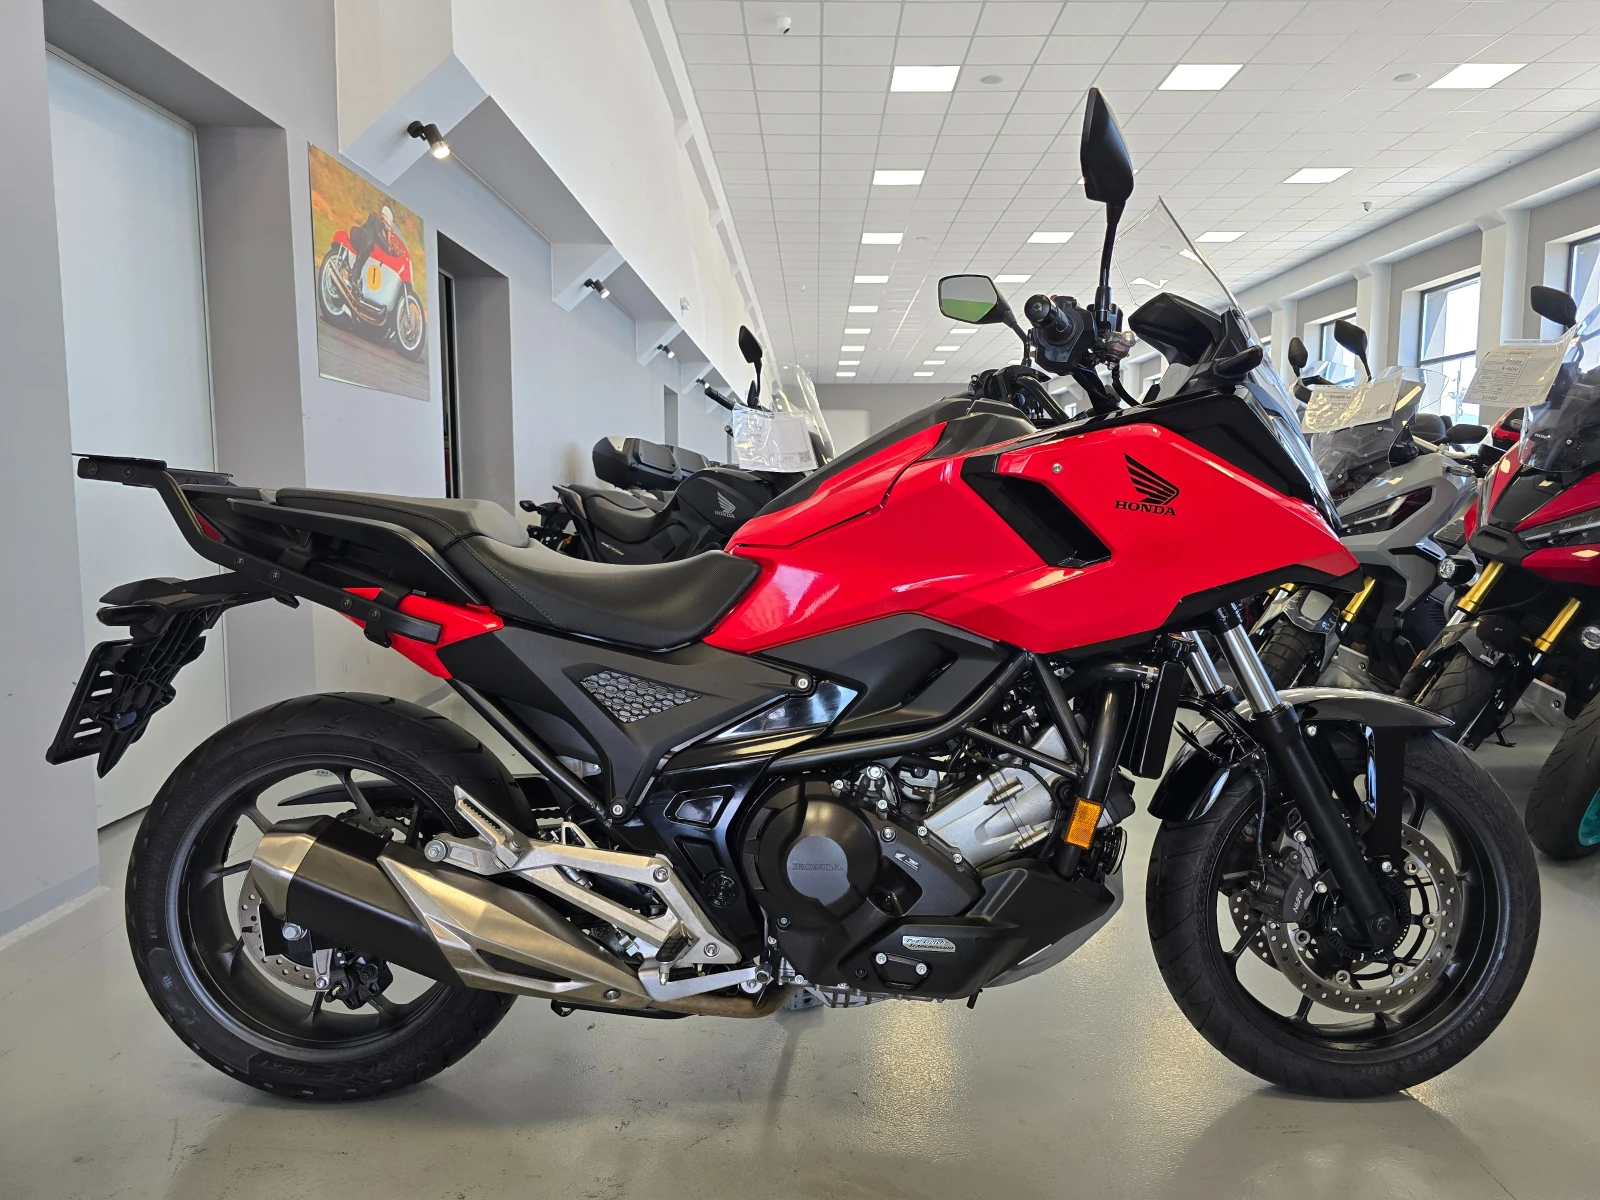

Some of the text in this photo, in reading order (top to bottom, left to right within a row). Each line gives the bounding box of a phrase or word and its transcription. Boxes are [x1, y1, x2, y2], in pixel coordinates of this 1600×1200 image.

[371, 267, 376, 284] 1
[714, 510, 735, 519] HONDA
[1114, 500, 1176, 516] HONDA
[791, 863, 844, 872] HONDA
[1293, 888, 1304, 913] NISSIN
